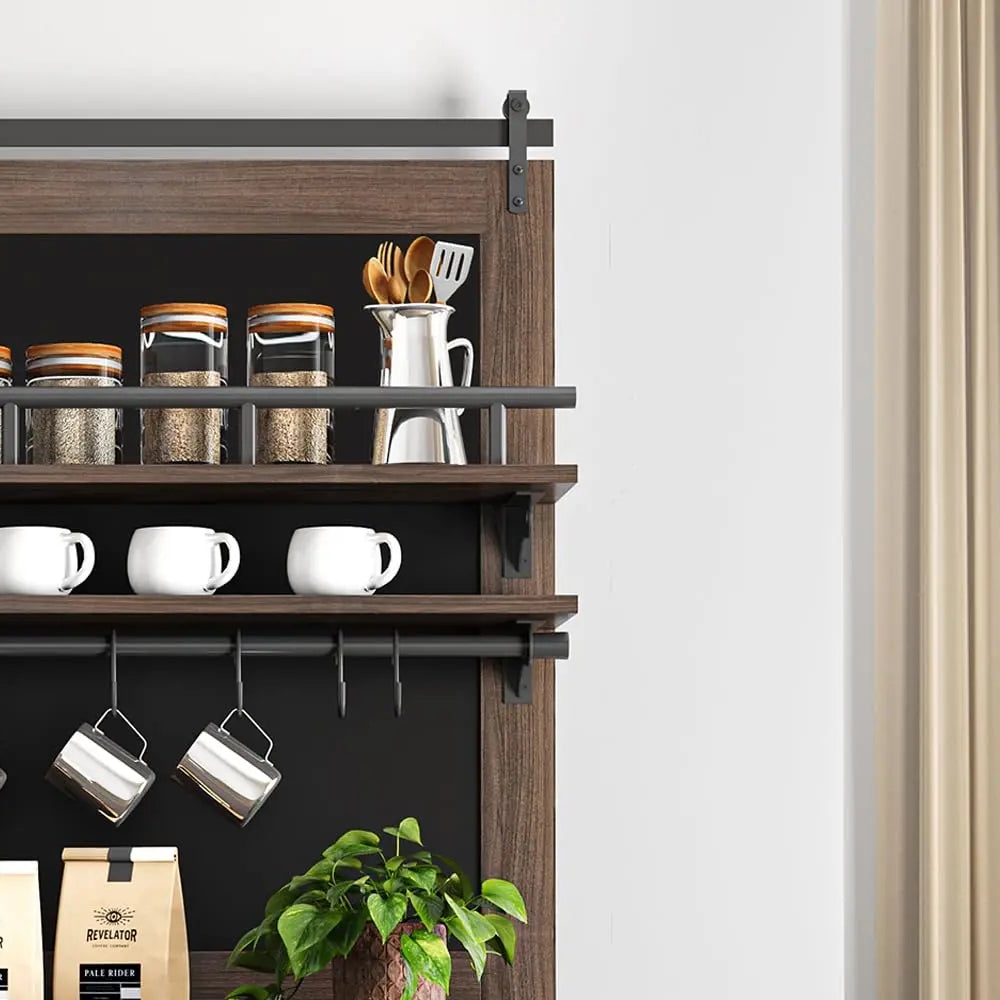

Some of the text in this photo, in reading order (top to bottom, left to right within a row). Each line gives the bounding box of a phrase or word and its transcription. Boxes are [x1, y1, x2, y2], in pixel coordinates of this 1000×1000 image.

[86, 929, 137, 942] REVELATOR
[84, 969, 136, 977] PALE RIDER
